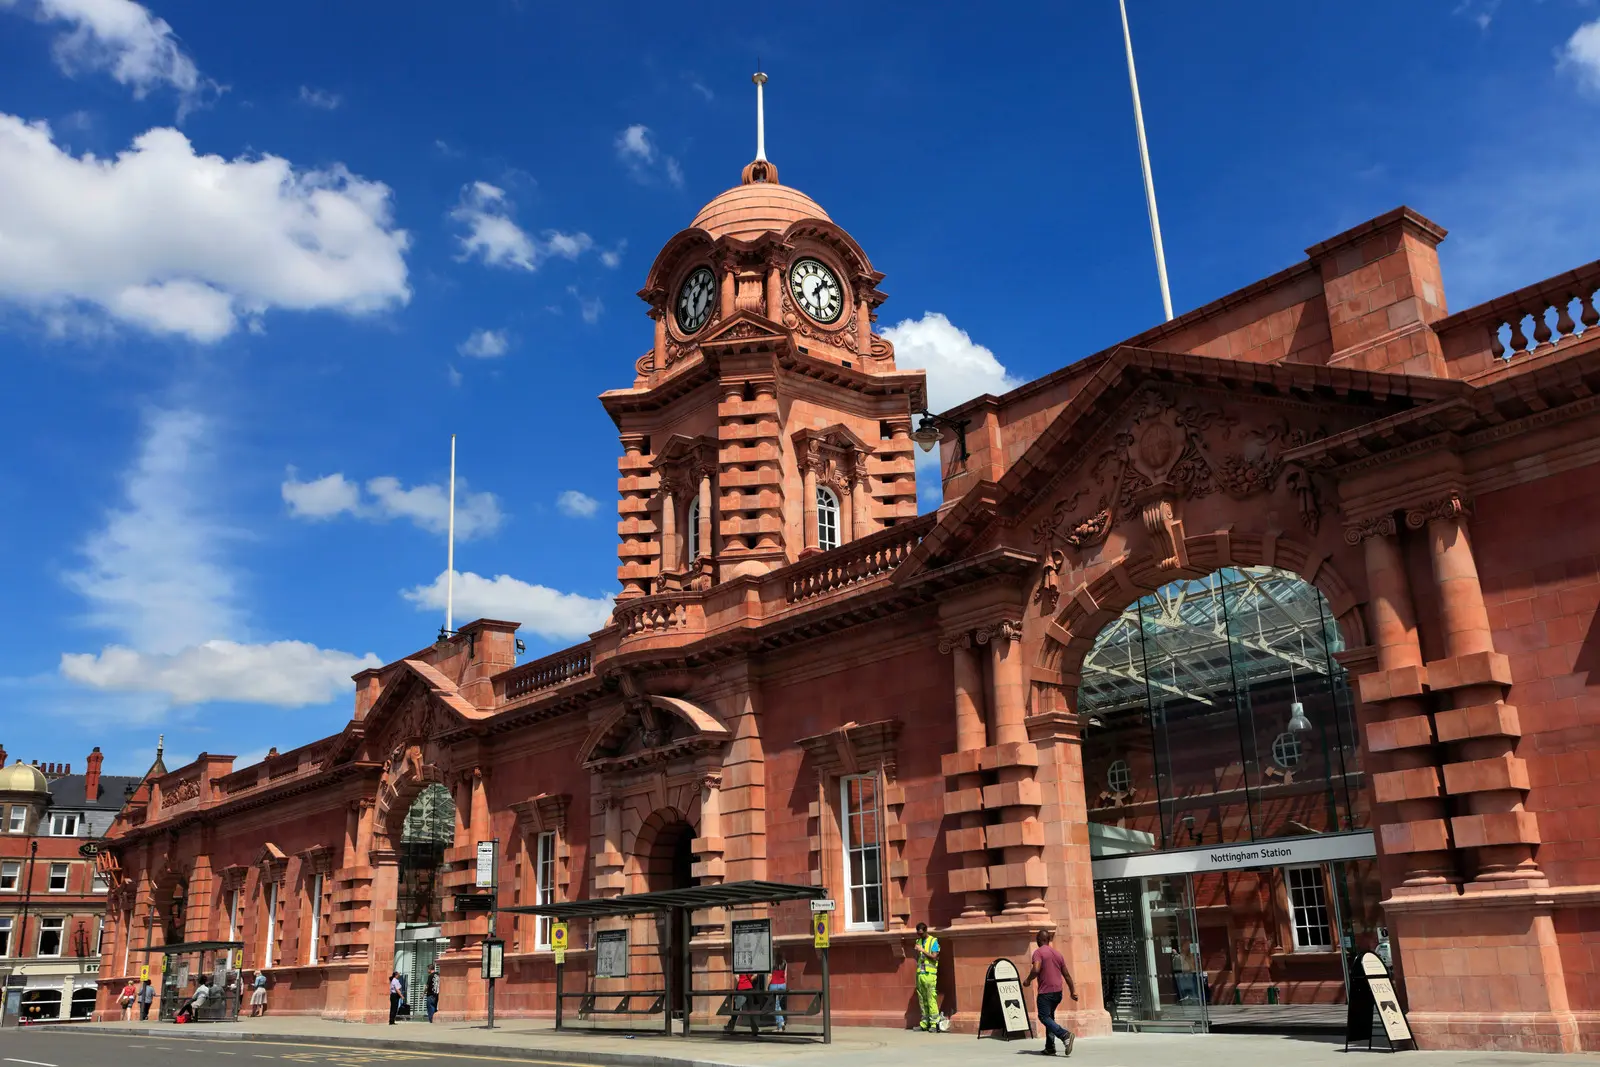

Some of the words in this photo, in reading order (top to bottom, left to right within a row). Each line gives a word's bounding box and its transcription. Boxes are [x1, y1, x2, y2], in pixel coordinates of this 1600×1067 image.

[1211, 852, 1259, 862] Nottingham
[1261, 848, 1292, 858] Station
[1000, 985, 1019, 994] OPEN
[1371, 983, 1392, 993] OPEN
